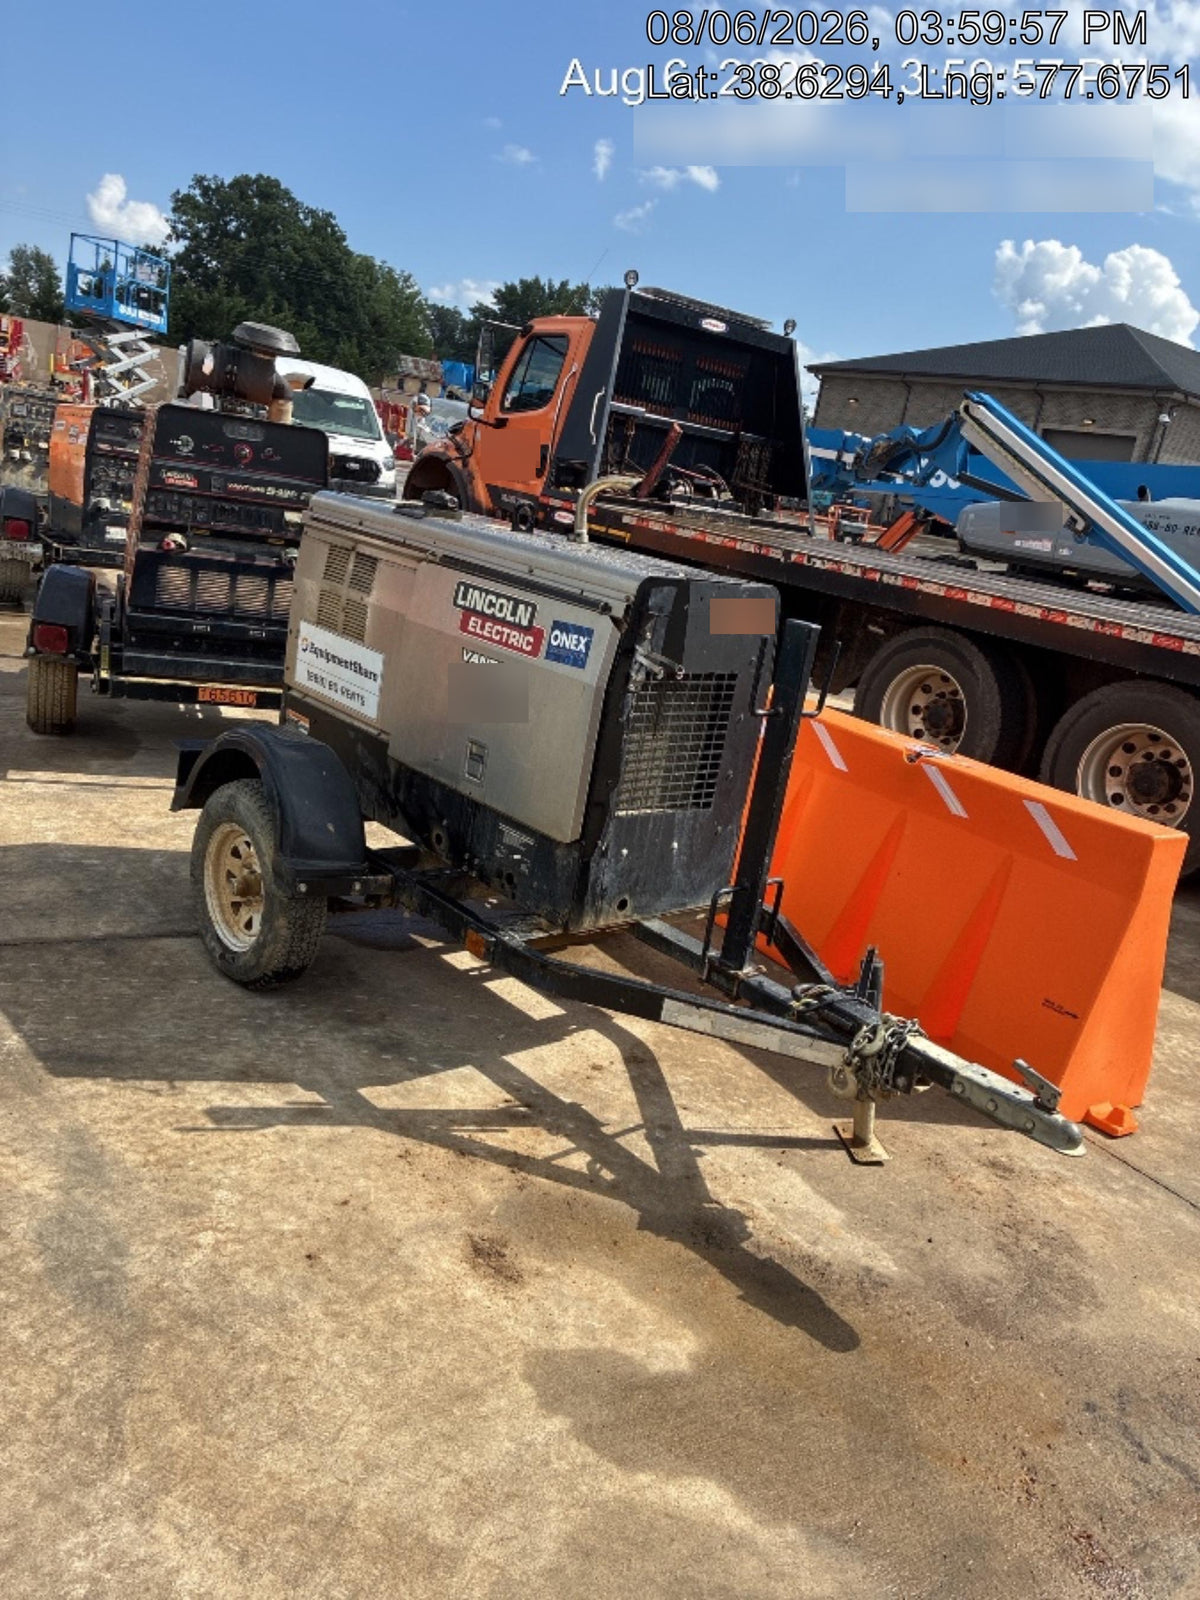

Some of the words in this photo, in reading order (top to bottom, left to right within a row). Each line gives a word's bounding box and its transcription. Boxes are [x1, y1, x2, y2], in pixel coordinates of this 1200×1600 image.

[456, 585, 533, 627] LINCOLN
[467, 616, 535, 652] ELECTRIC
[550, 630, 587, 653] ONEX
